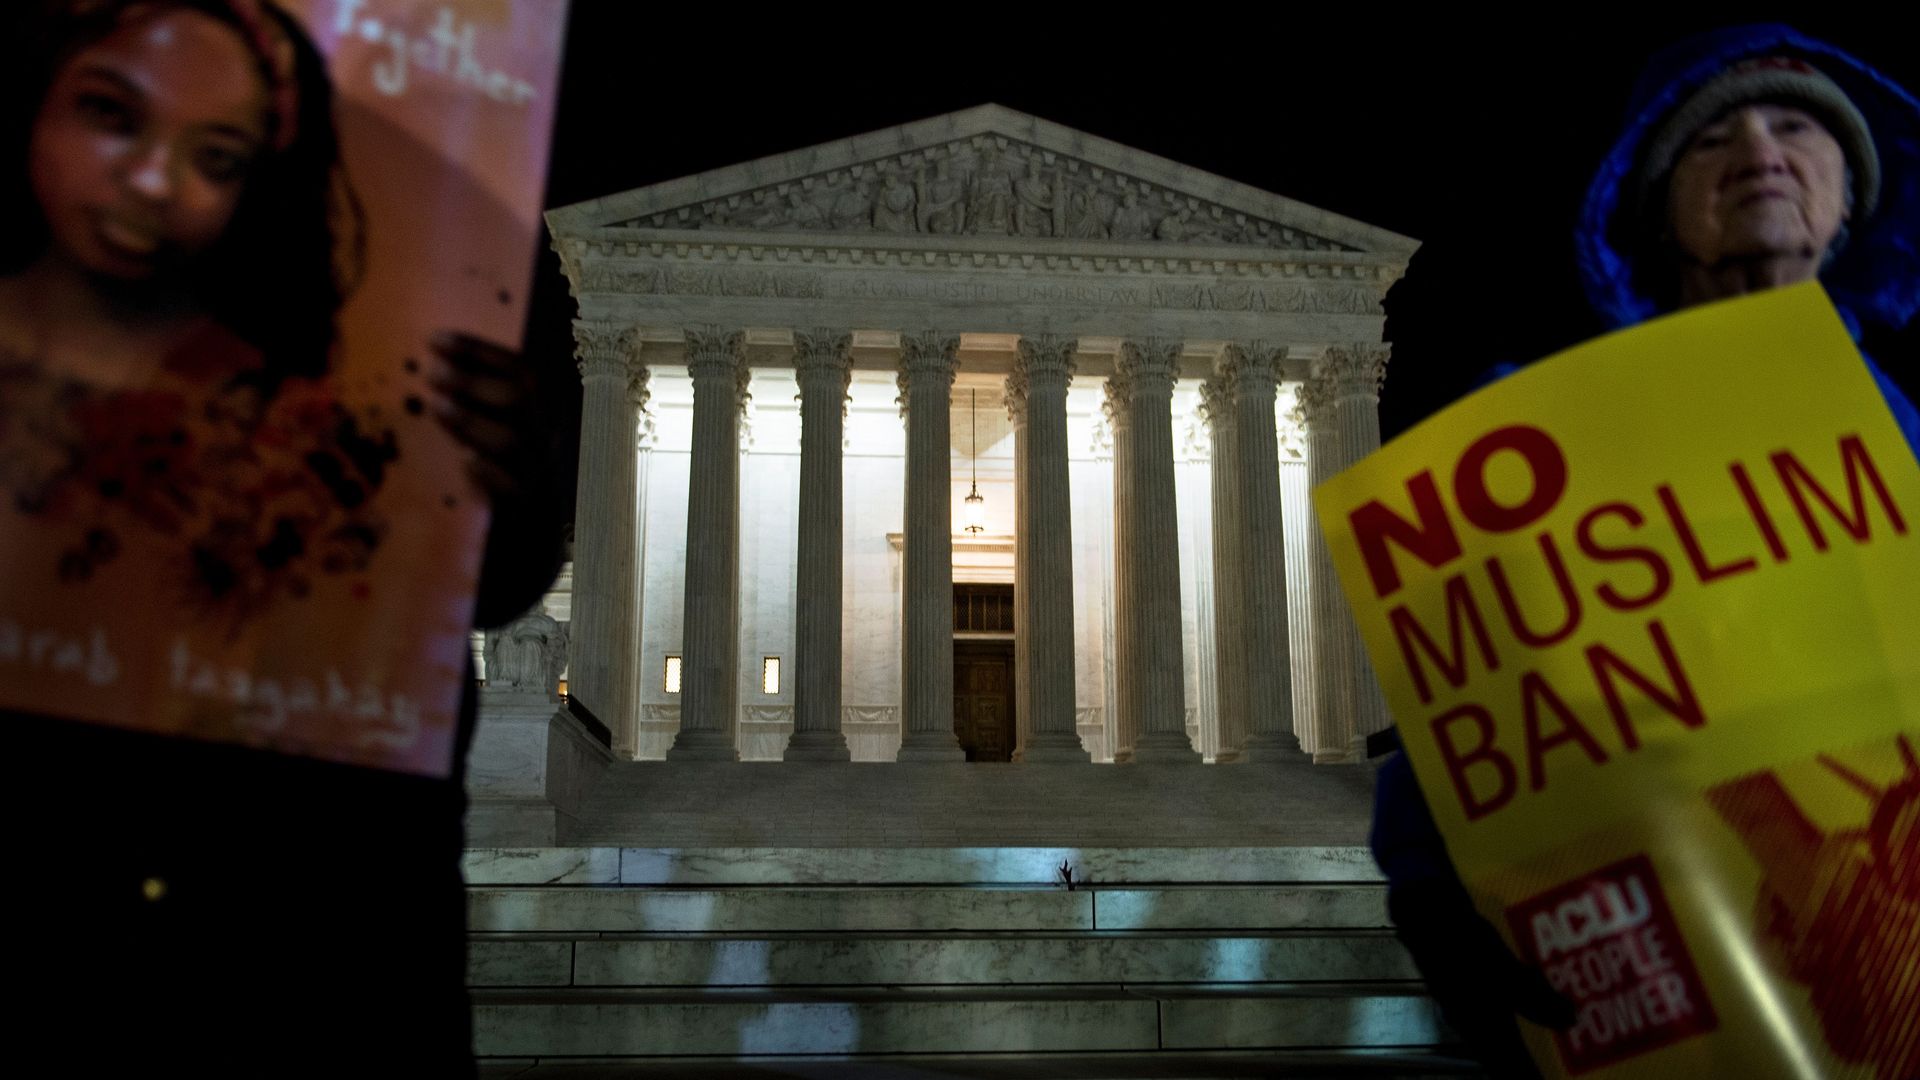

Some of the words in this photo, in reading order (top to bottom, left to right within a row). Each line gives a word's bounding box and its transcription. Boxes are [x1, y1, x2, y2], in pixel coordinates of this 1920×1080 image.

[1347, 423, 1569, 599] NO
[1387, 433, 1909, 704] MUSLIM
[1430, 619, 1707, 822] BAN
[1531, 874, 1652, 962] ACLU
[1568, 972, 1696, 1051] POWER
